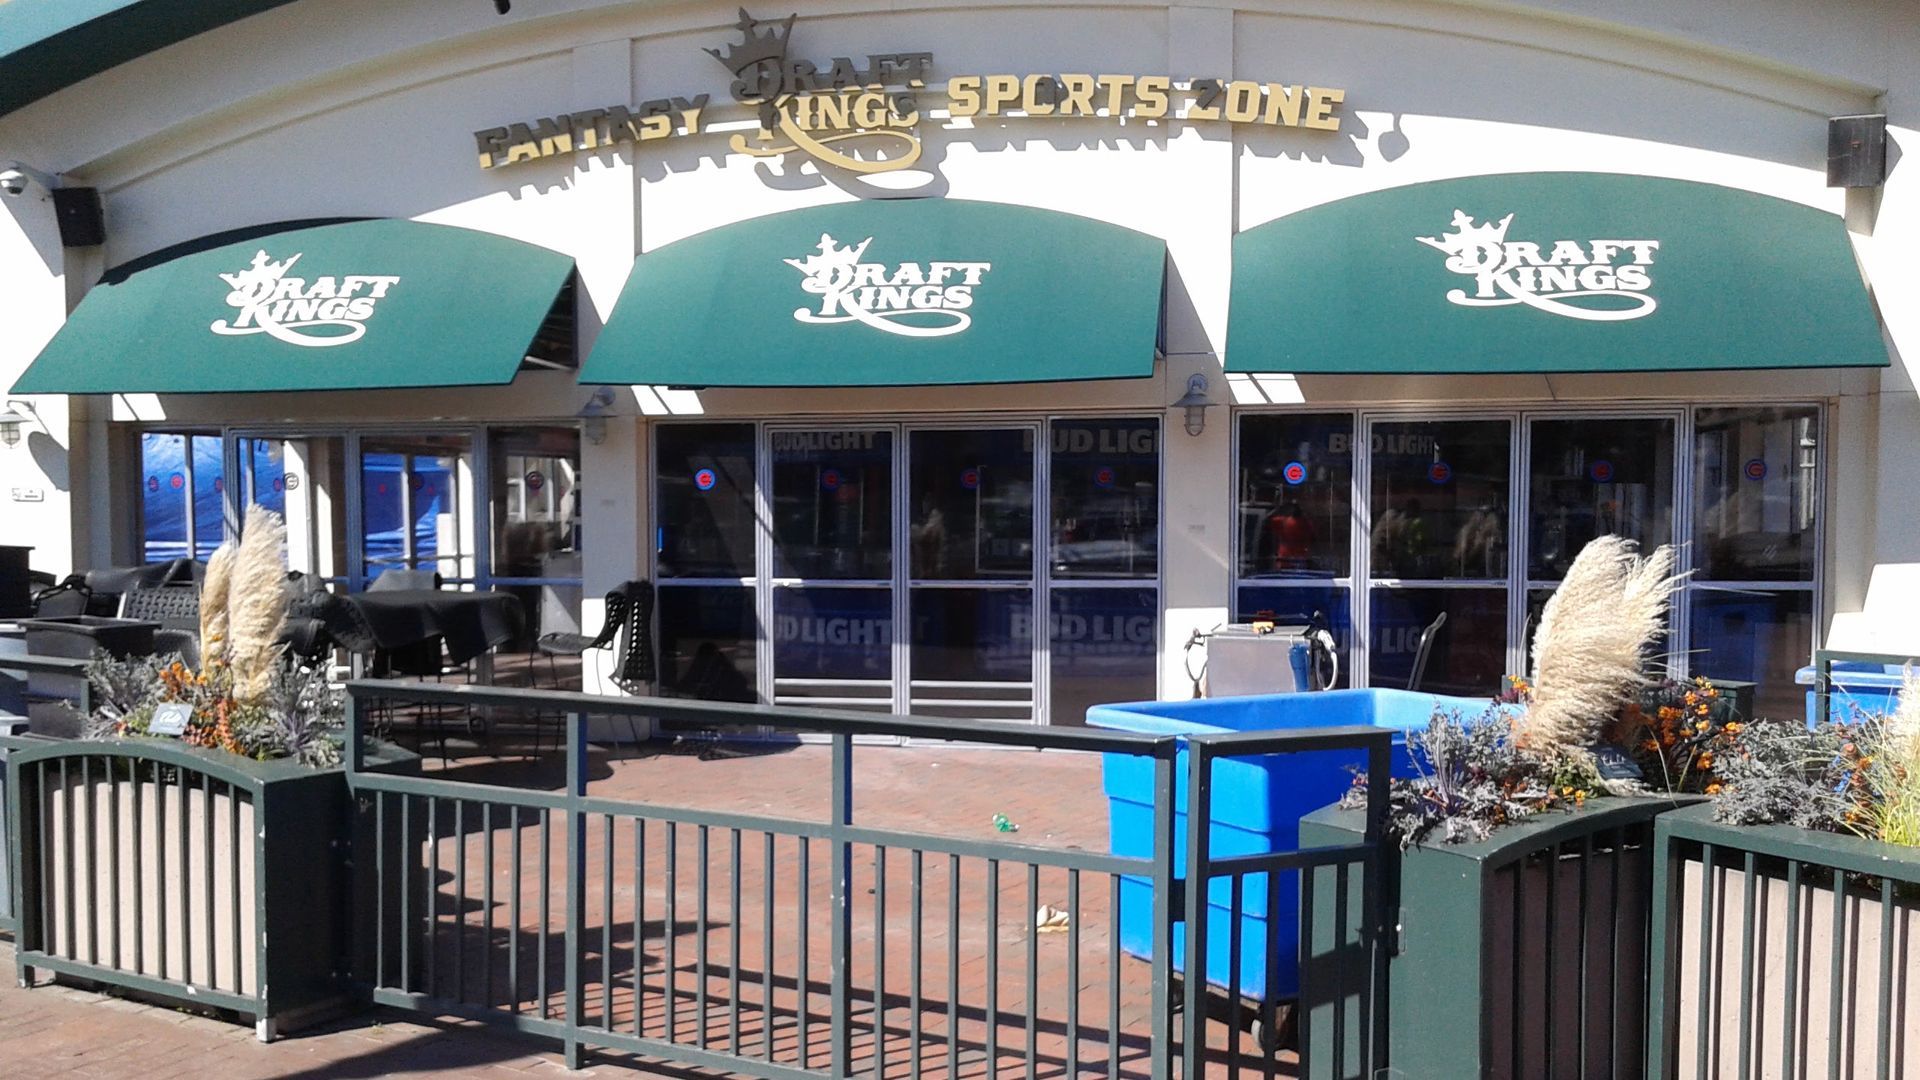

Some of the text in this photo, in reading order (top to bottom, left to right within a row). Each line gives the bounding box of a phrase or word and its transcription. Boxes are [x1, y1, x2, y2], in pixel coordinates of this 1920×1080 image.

[730, 52, 933, 102] DRAFT
[947, 74, 1345, 131] SPORTS ZONE
[474, 94, 710, 169] FANTASY
[801, 262, 991, 294] DRAFT
[1445, 240, 1660, 274] DRAFT
[226, 275, 400, 307] DRAFT
